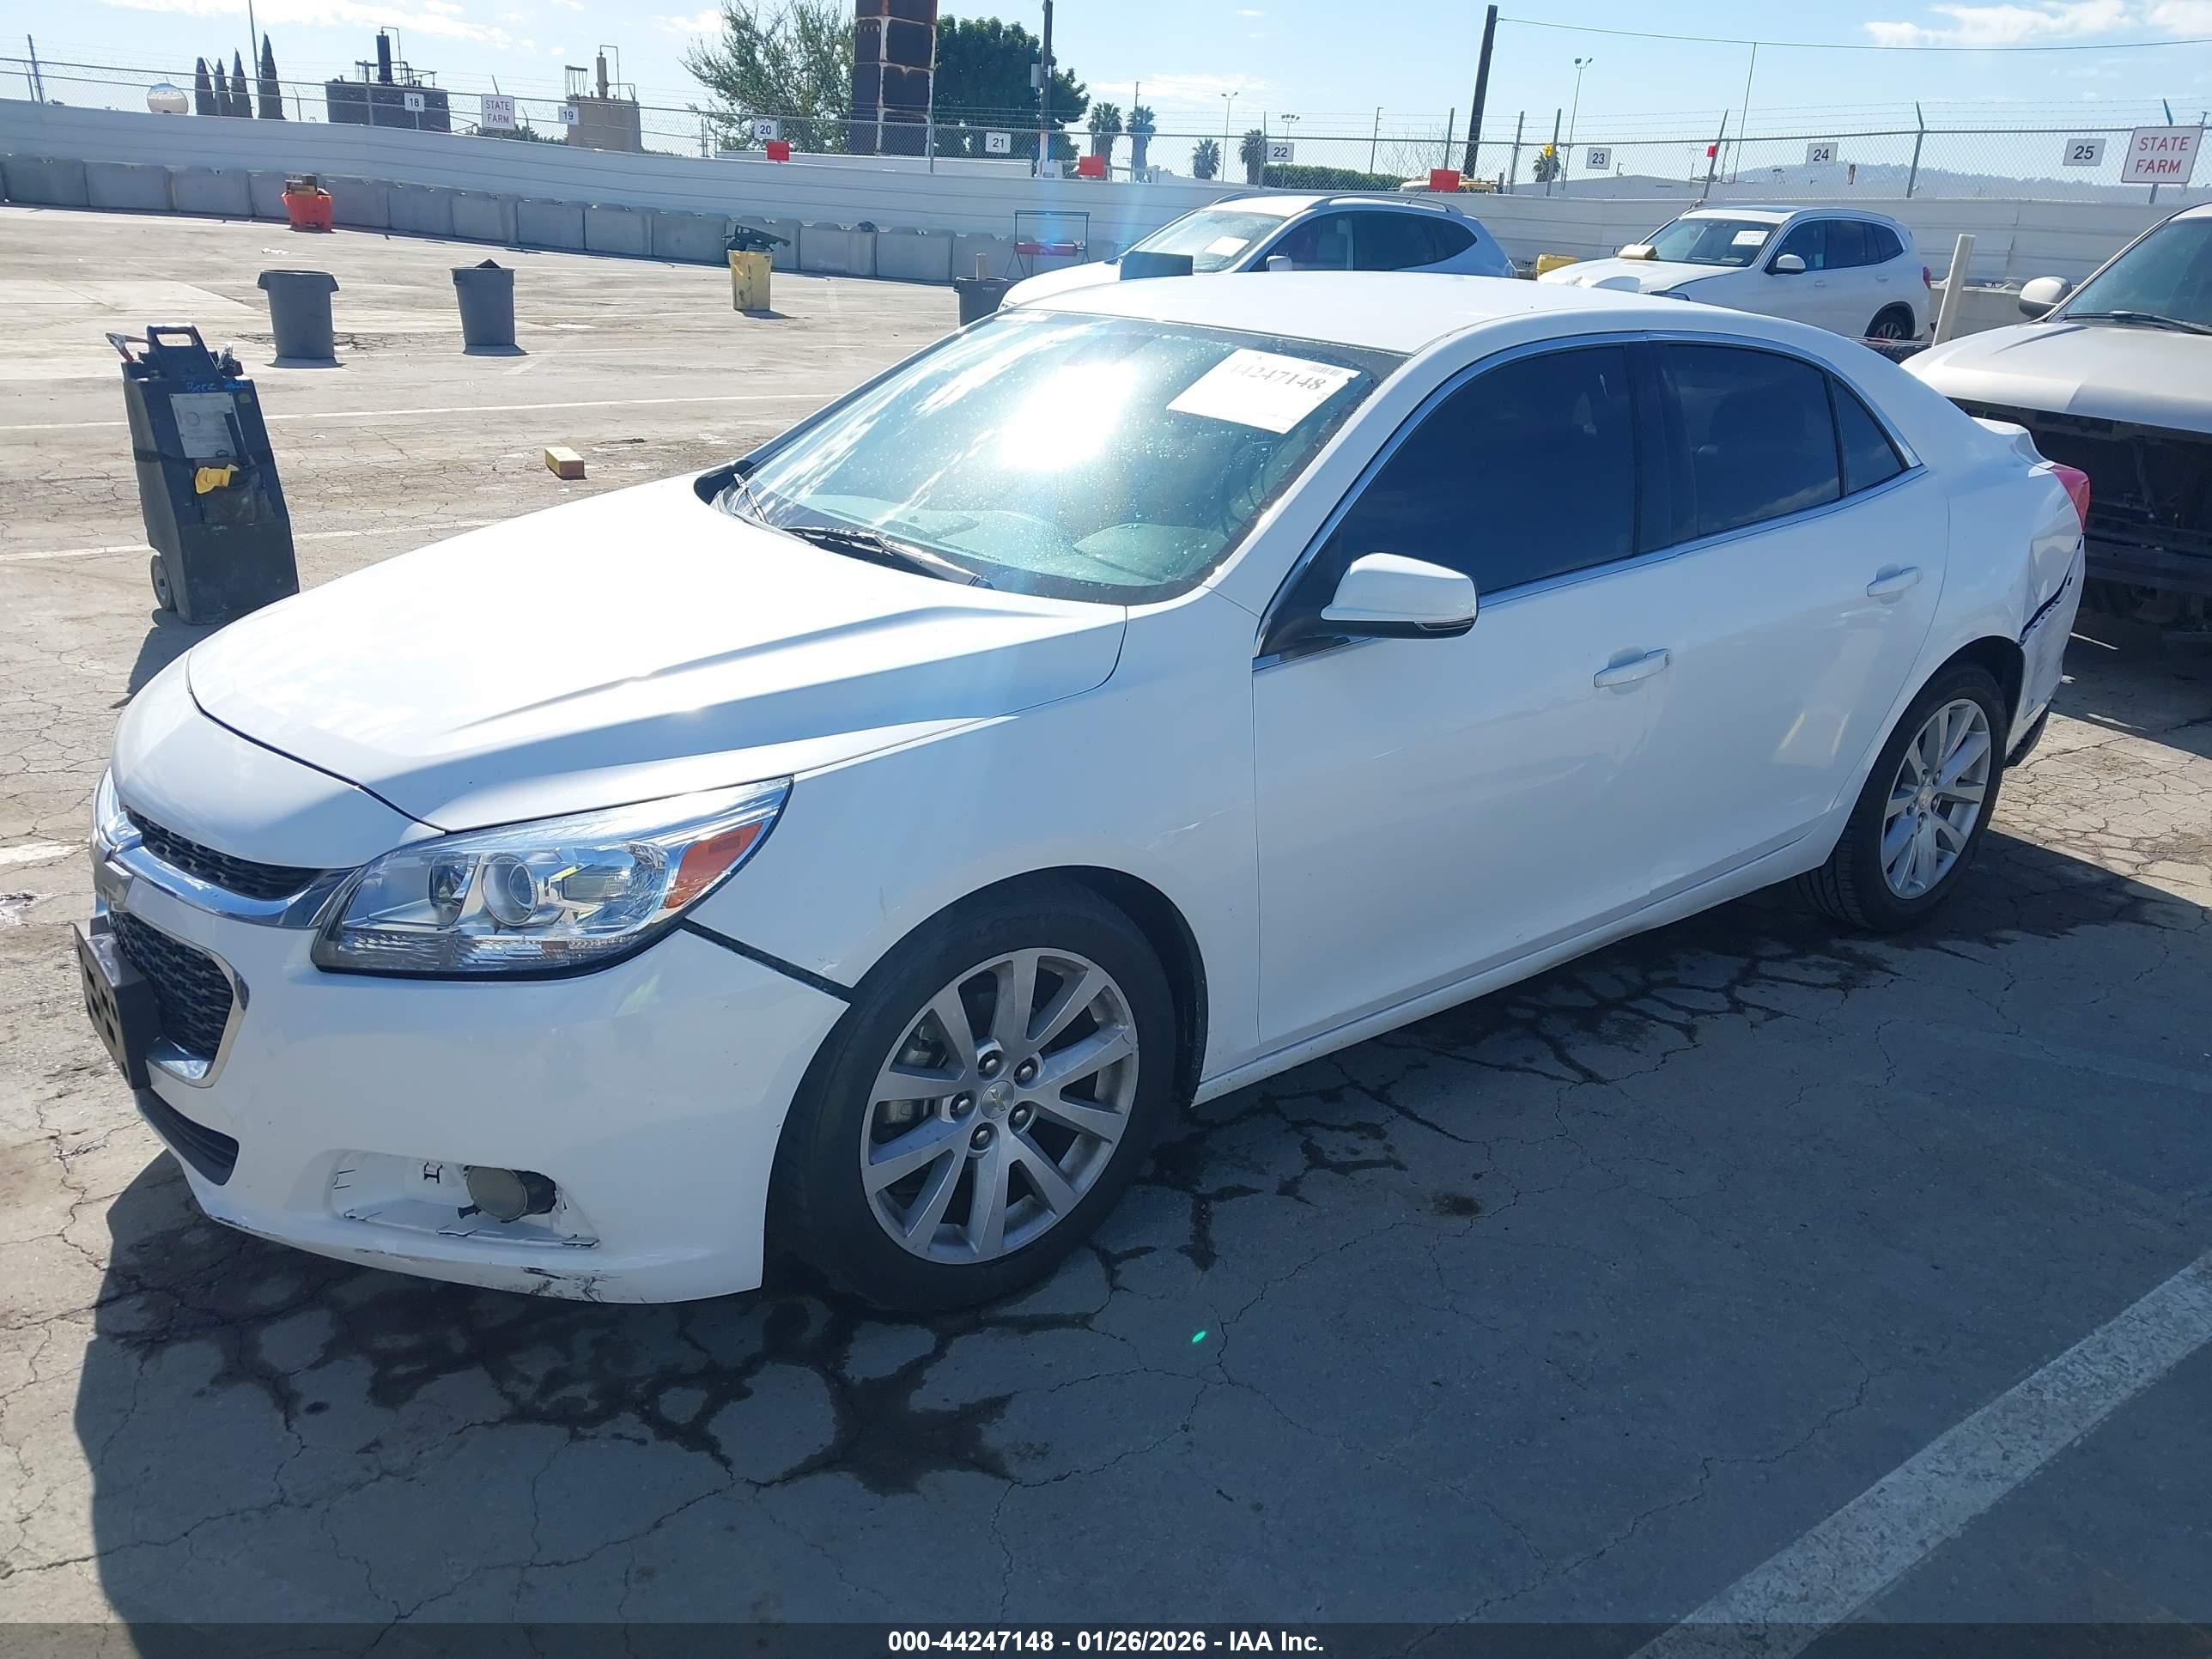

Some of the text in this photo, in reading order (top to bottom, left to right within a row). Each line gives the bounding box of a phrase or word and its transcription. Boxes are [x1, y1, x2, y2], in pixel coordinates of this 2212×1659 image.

[410, 97, 420, 107] 18
[486, 100, 510, 111] STATE
[487, 113, 509, 125] FARM
[563, 111, 574, 120] 19
[760, 125, 771, 135] 20
[993, 137, 1004, 148] 21
[2138, 137, 2191, 151] STATE
[1273, 147, 1288, 157] 22
[1813, 149, 1829, 161] 24
[2073, 145, 2095, 160] 25
[1592, 152, 1605, 164] 23
[2135, 159, 2182, 173] FARM
